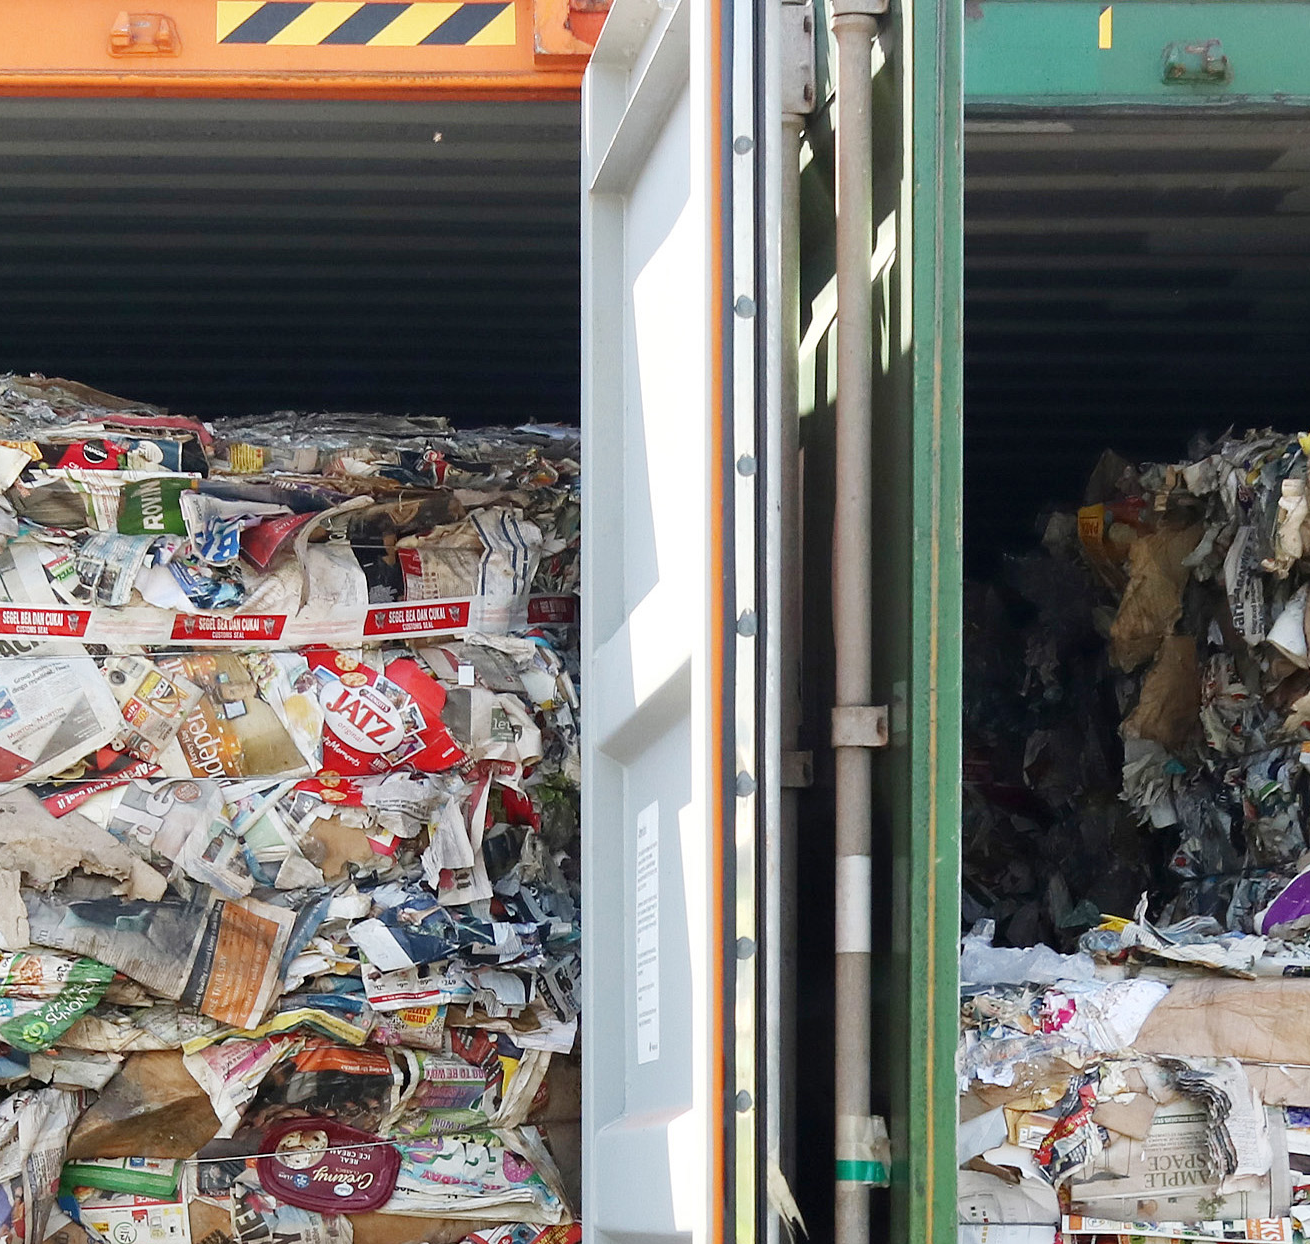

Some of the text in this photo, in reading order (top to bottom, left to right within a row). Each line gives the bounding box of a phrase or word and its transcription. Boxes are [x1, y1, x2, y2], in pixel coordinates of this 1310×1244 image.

[3, 611, 64, 626] SEGEL BEA DAN CUKAI
[389, 607, 446, 624] SEGEL BEA DAN CUKAI
[199, 618, 260, 631] SEGEL BEA DAN CUKAI
[325, 688, 396, 746] JATZ
[337, 722, 365, 743] original
[403, 1013, 428, 1024] INSIDE
[447, 1068, 459, 1080] BE
[329, 1149, 371, 1160] ICE CREAM
[339, 1156, 359, 1165] REAL
[1147, 1151, 1207, 1171] SPACE
[312, 1165, 374, 1189] Creamy
